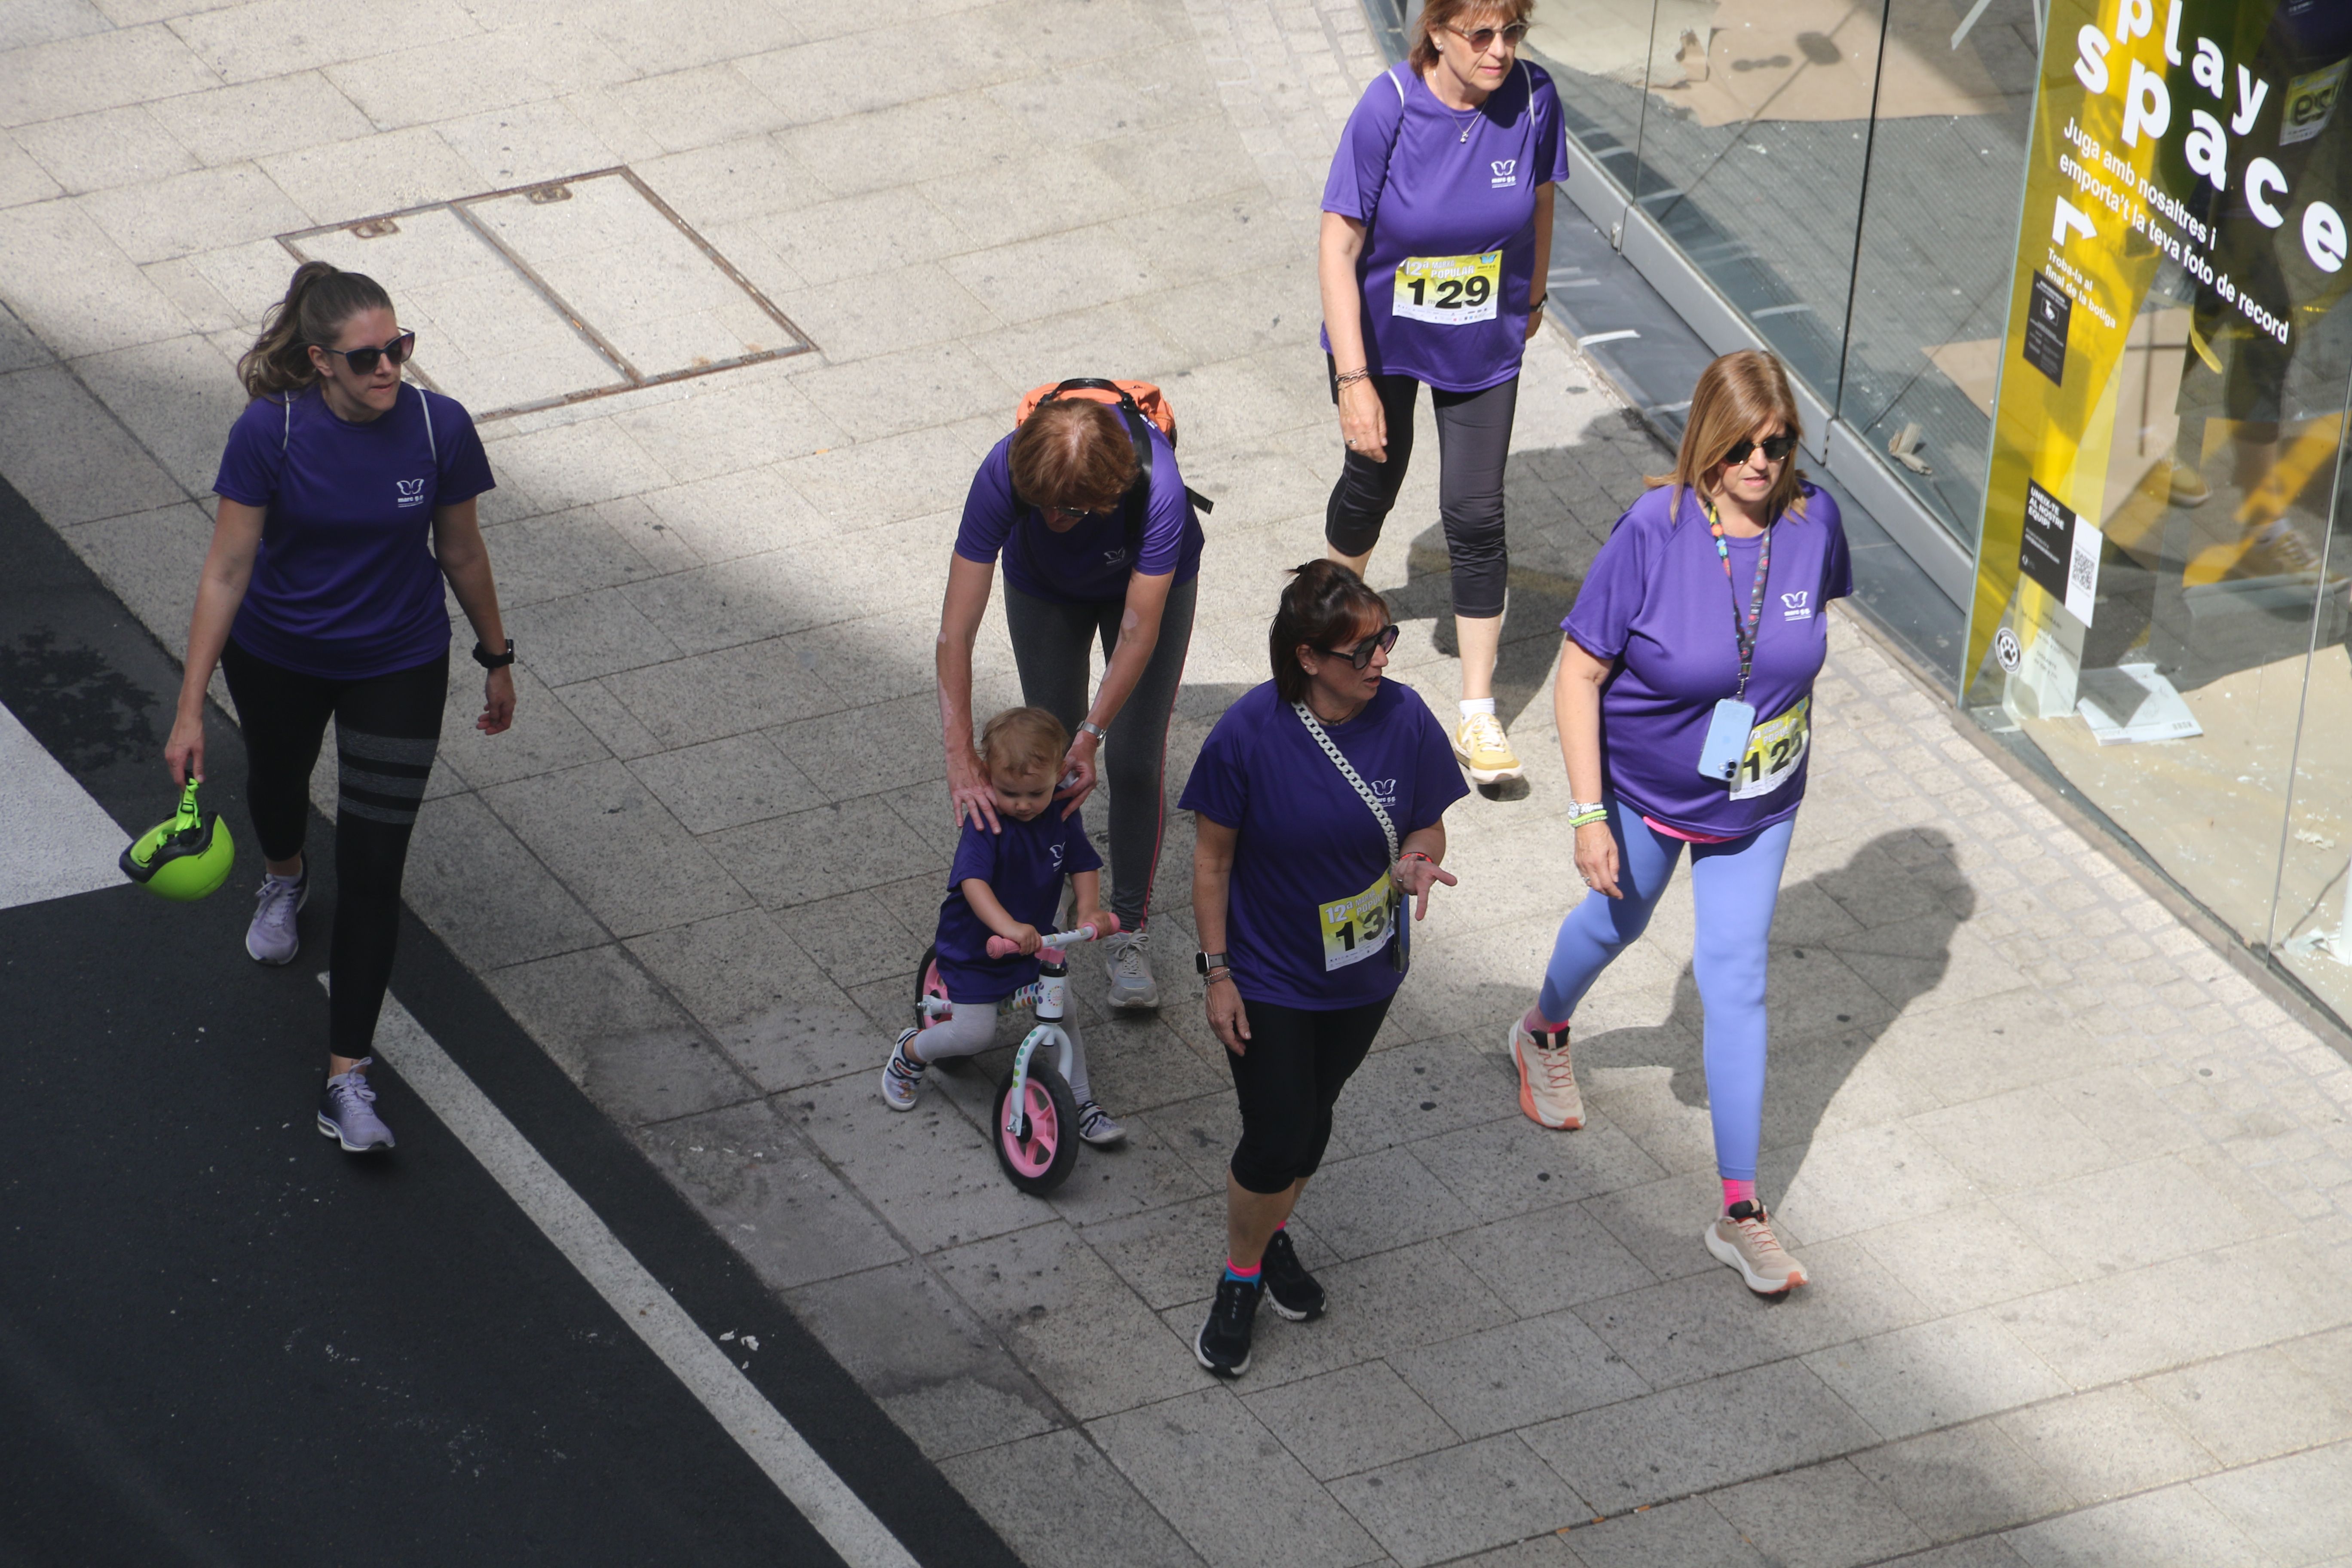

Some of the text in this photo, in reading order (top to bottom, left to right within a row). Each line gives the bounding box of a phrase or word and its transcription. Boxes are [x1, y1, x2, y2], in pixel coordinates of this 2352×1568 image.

[2116, 0, 2269, 135] play
[2073, 24, 2348, 273] space
[2064, 116, 2217, 251] Juga amb nosaltres i
[1432, 260, 1455, 269] MARXA
[2059, 153, 2290, 345] emporta't la teva foto de record
[1430, 265, 1475, 279] POPULAR
[2048, 247, 2093, 292] Troba-la al
[1407, 275, 1491, 309] 129
[2045, 263, 2065, 288] final
[2066, 282, 2077, 298] de
[2079, 289, 2087, 306] la
[2088, 297, 2116, 329] botiga
[2030, 486, 2060, 516] UNEIX-TE
[2039, 503, 2065, 531] NOSTRE
[1355, 889, 1375, 907] MARXA
